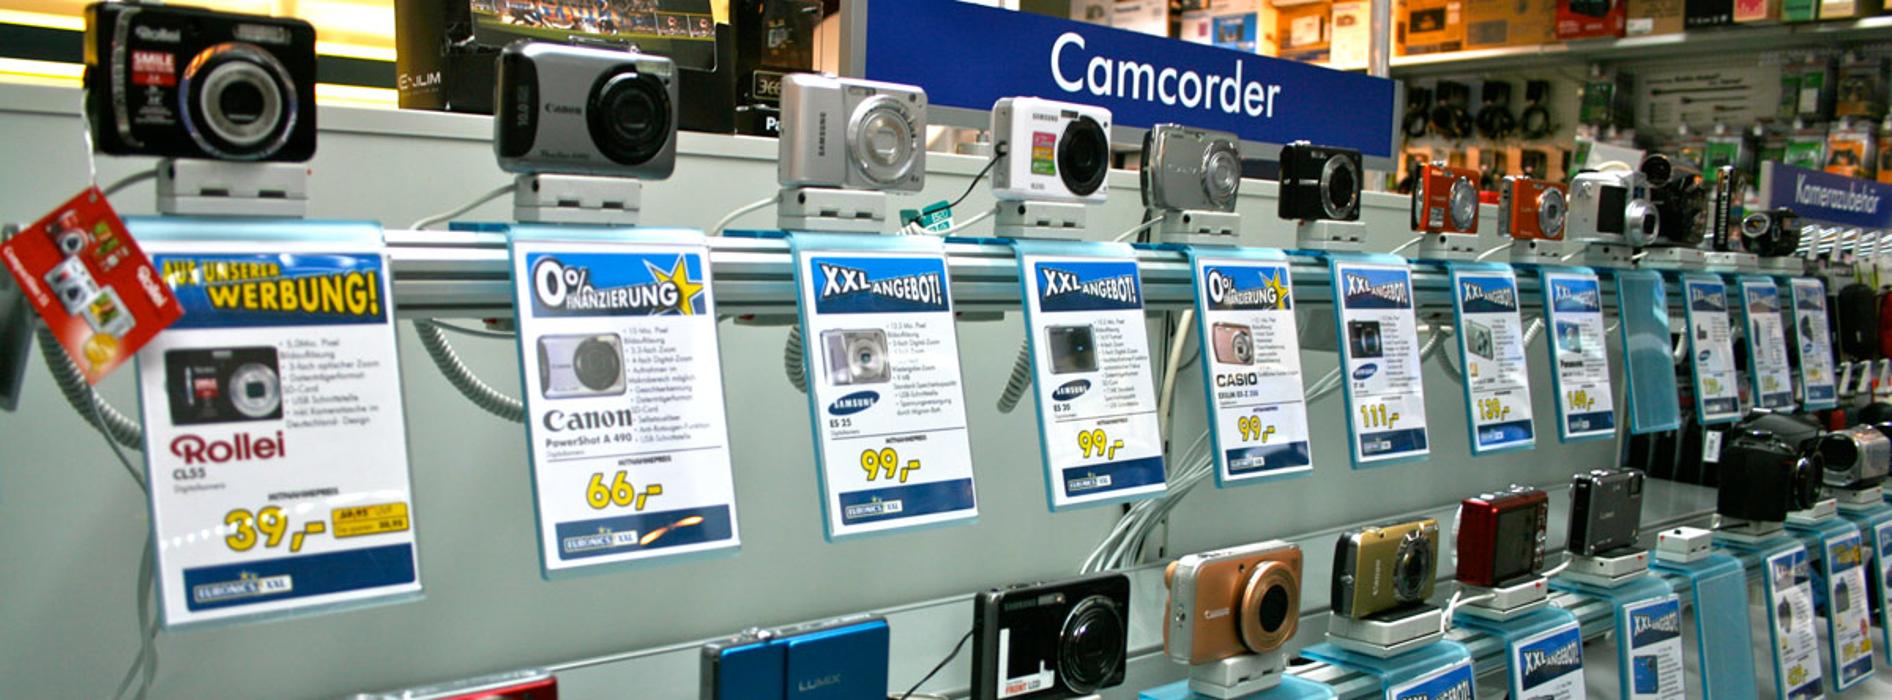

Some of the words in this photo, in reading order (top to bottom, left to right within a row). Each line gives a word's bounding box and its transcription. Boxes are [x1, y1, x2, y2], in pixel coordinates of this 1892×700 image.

[133, 52, 175, 63] SMILE
[1050, 32, 1281, 118] Camcorder
[1032, 112, 1059, 122] SAMSUNG
[818, 112, 826, 156] SAMSUNG
[162, 260, 196, 286] AUS
[203, 262, 281, 282] UNSERER
[533, 256, 595, 308] 0%
[820, 262, 872, 297] XXL
[872, 272, 942, 306] ANGEBOT!
[1346, 272, 1370, 297] XXL
[207, 268, 380, 316] WERBUNG!
[566, 281, 680, 310] FINANZIERUNG
[1042, 268, 1082, 297] XXL
[1082, 276, 1136, 304] ANGEBOT!
[1464, 282, 1484, 302] XXL
[1216, 372, 1258, 388] CASIO
[833, 394, 875, 410] SAMSUNG
[542, 408, 632, 432] Canon
[830, 418, 841, 428] ES
[169, 430, 286, 465] Rollei
[545, 434, 600, 449] PowerShot
[604, 434, 611, 444] A
[614, 432, 632, 443] 490
[1078, 428, 1124, 460] 99,-
[172, 468, 207, 481] CL55
[860, 446, 921, 483] 99,-
[586, 470, 663, 512] 66,-
[197, 580, 260, 600] EURONICS
[266, 576, 288, 592] XXL
[1634, 613, 1651, 637] XXL
[1524, 650, 1546, 676] XXL
[798, 673, 841, 692] LUMIX
